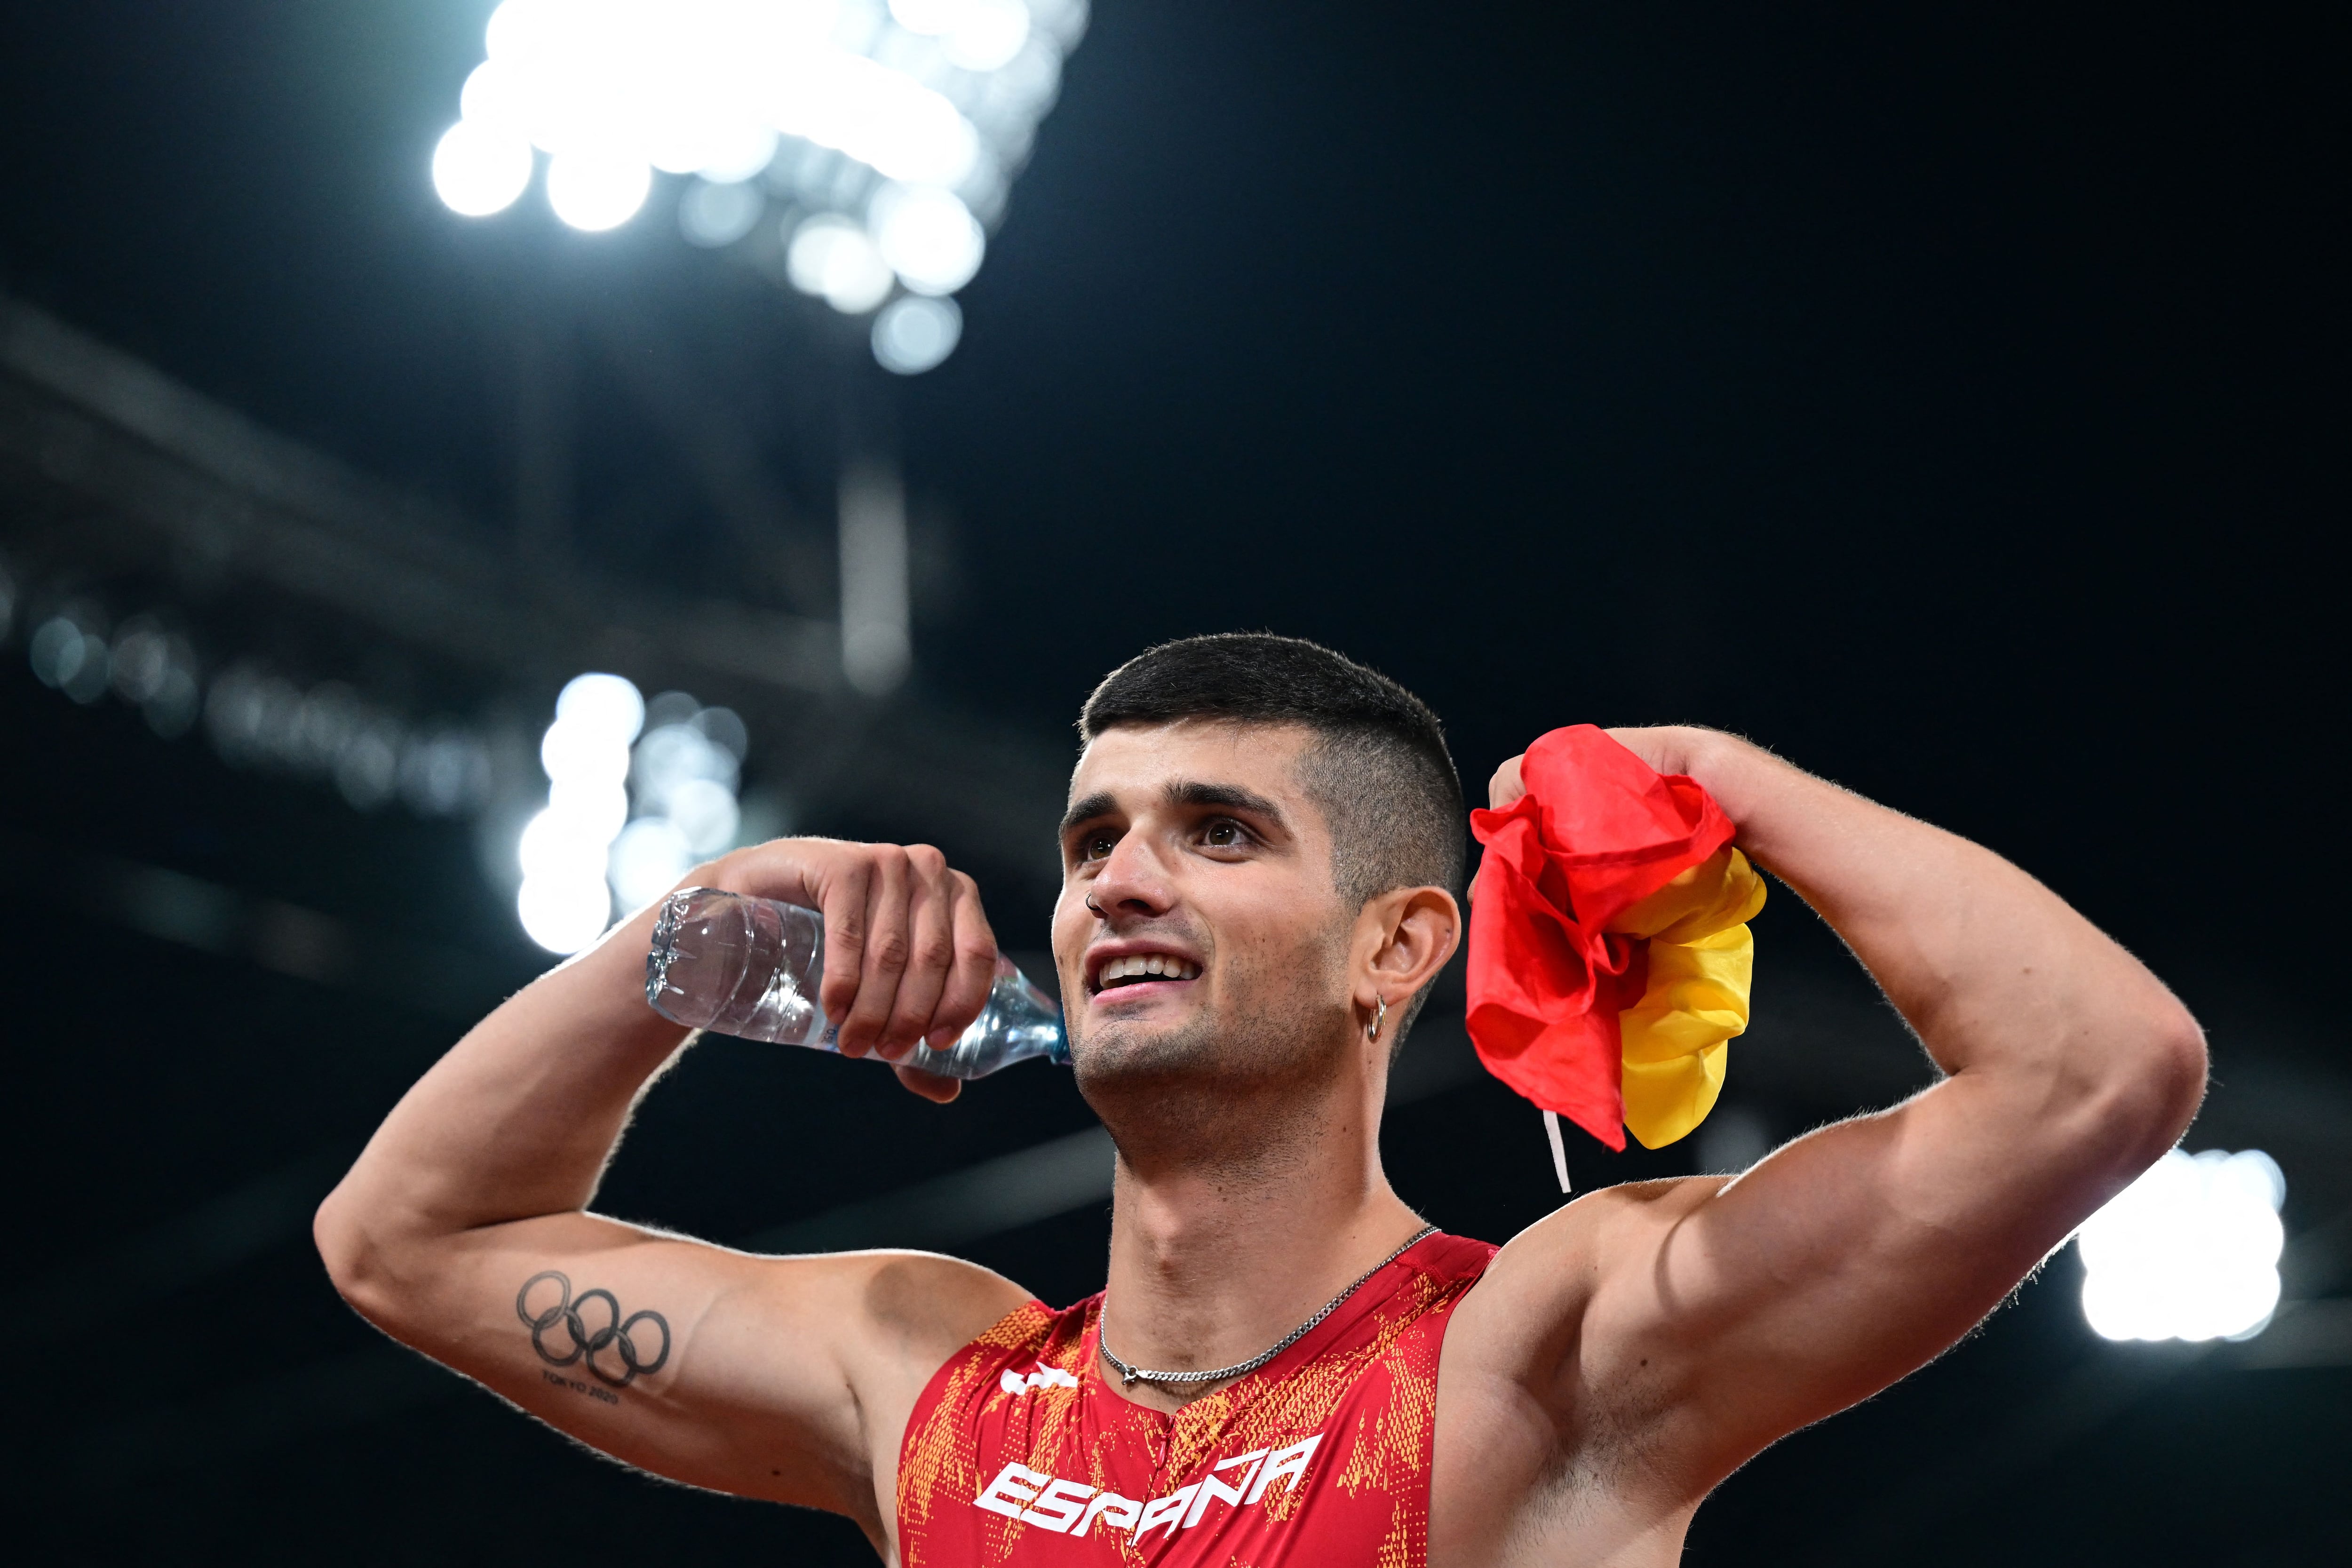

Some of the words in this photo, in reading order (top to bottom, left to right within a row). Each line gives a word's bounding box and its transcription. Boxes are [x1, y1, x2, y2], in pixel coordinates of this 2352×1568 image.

[542, 1369, 587, 1393] TOKYO
[589, 1386, 618, 1404] 2020
[973, 1432, 1324, 1549] ESPAÑA
